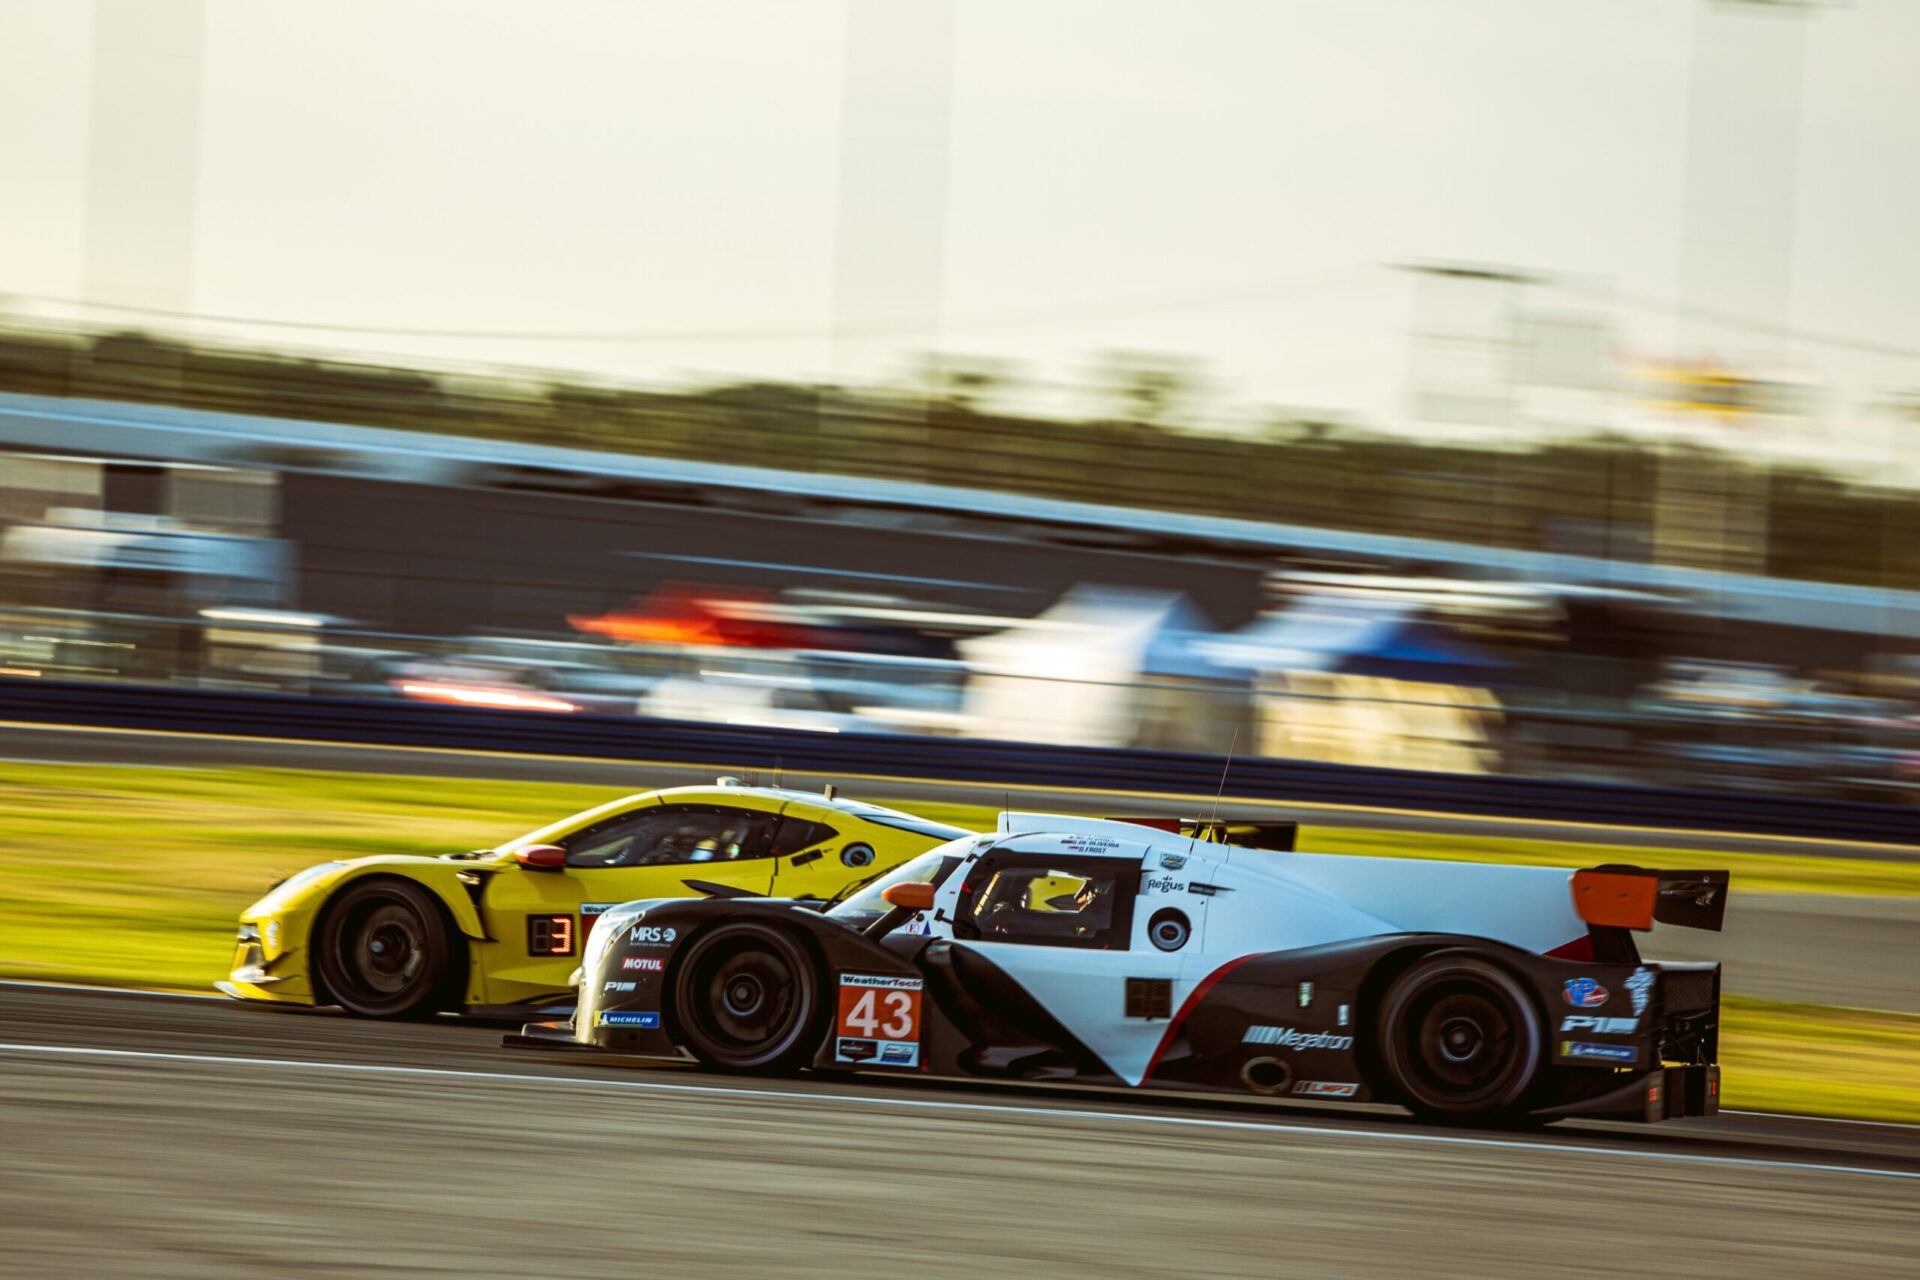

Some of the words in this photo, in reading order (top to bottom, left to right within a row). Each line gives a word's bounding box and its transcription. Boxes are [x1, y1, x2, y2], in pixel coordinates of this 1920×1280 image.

[1147, 879, 1185, 893] Regus
[551, 918, 571, 953] 3
[631, 926, 662, 942] MRS
[623, 958, 662, 970] MOTUL
[843, 975, 922, 988] WeatherTech
[609, 1016, 653, 1024] MICHELIN
[845, 990, 913, 1039] 43
[1276, 1027, 1354, 1051] Megatron
